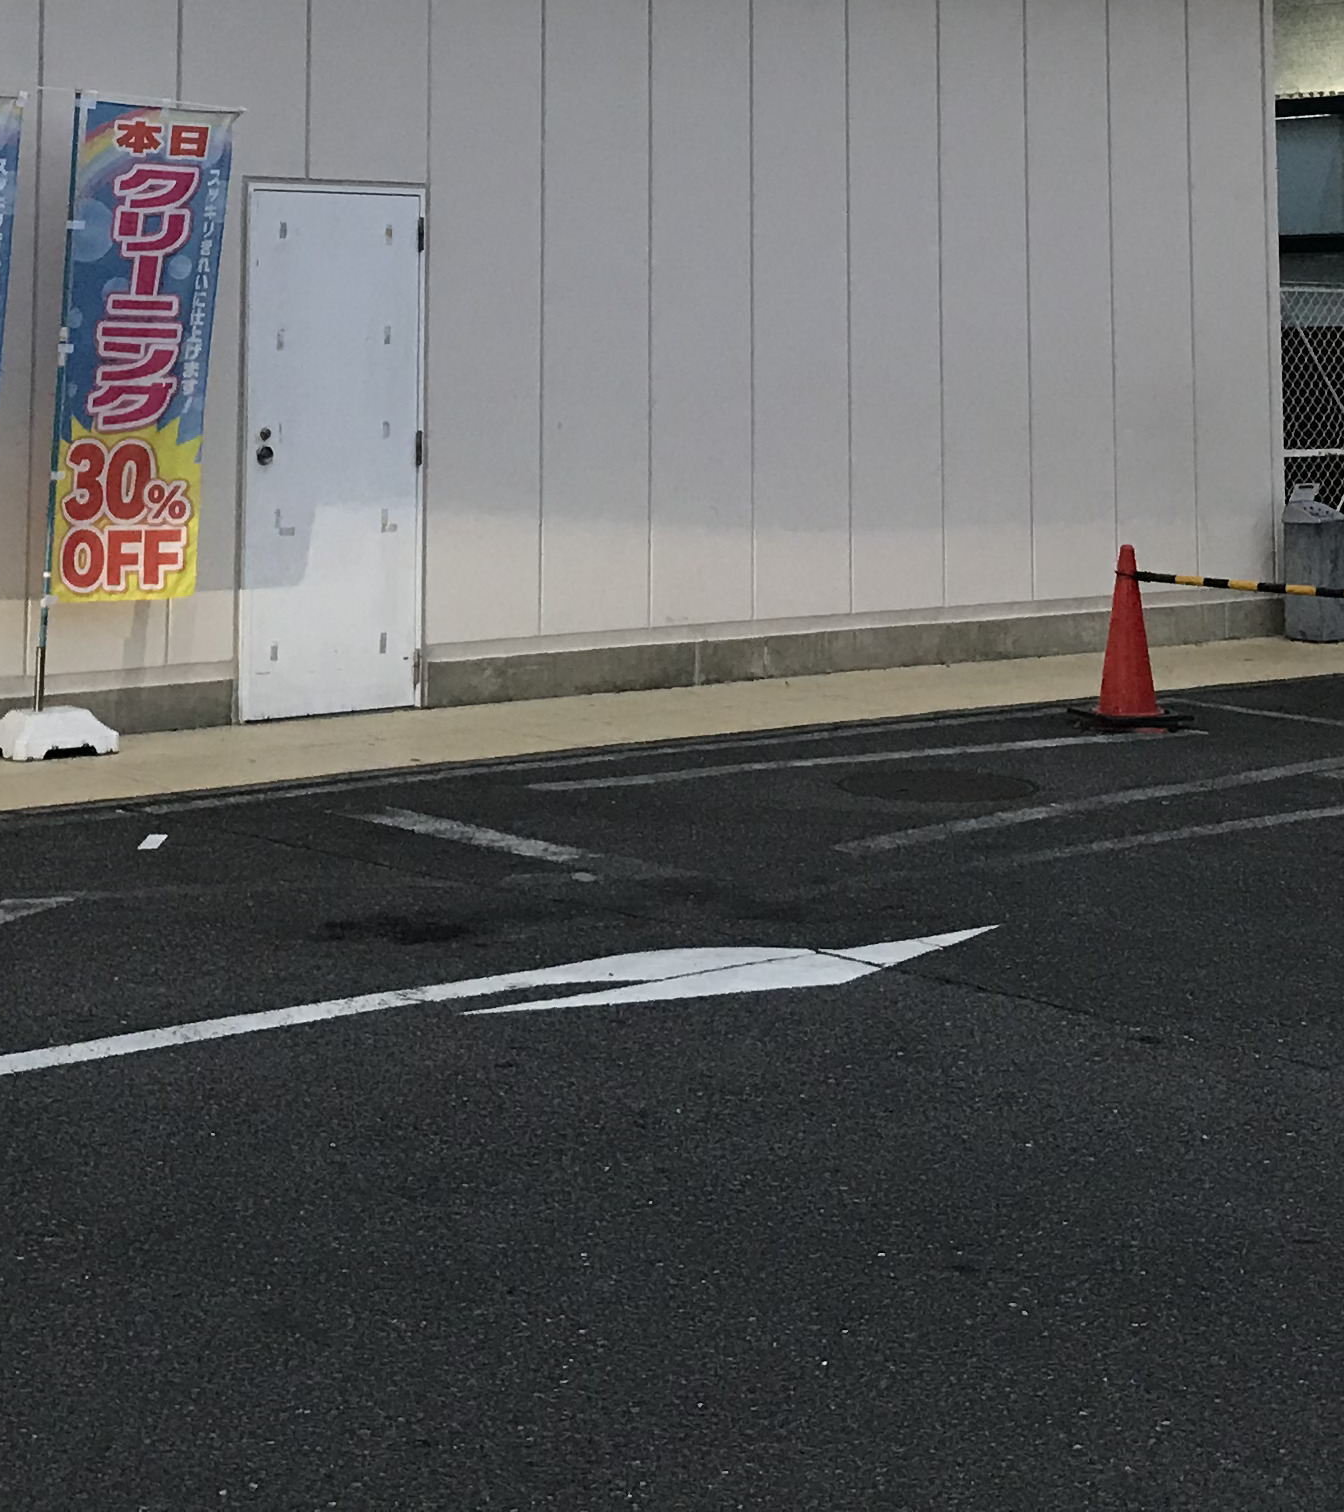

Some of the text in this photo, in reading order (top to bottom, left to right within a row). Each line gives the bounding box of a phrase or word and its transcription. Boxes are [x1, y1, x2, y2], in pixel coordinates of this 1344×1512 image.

[114, 118, 212, 159] 本日
[88, 164, 201, 431] クリーニング
[63, 439, 190, 525] 30%
[61, 525, 188, 595] OFF
